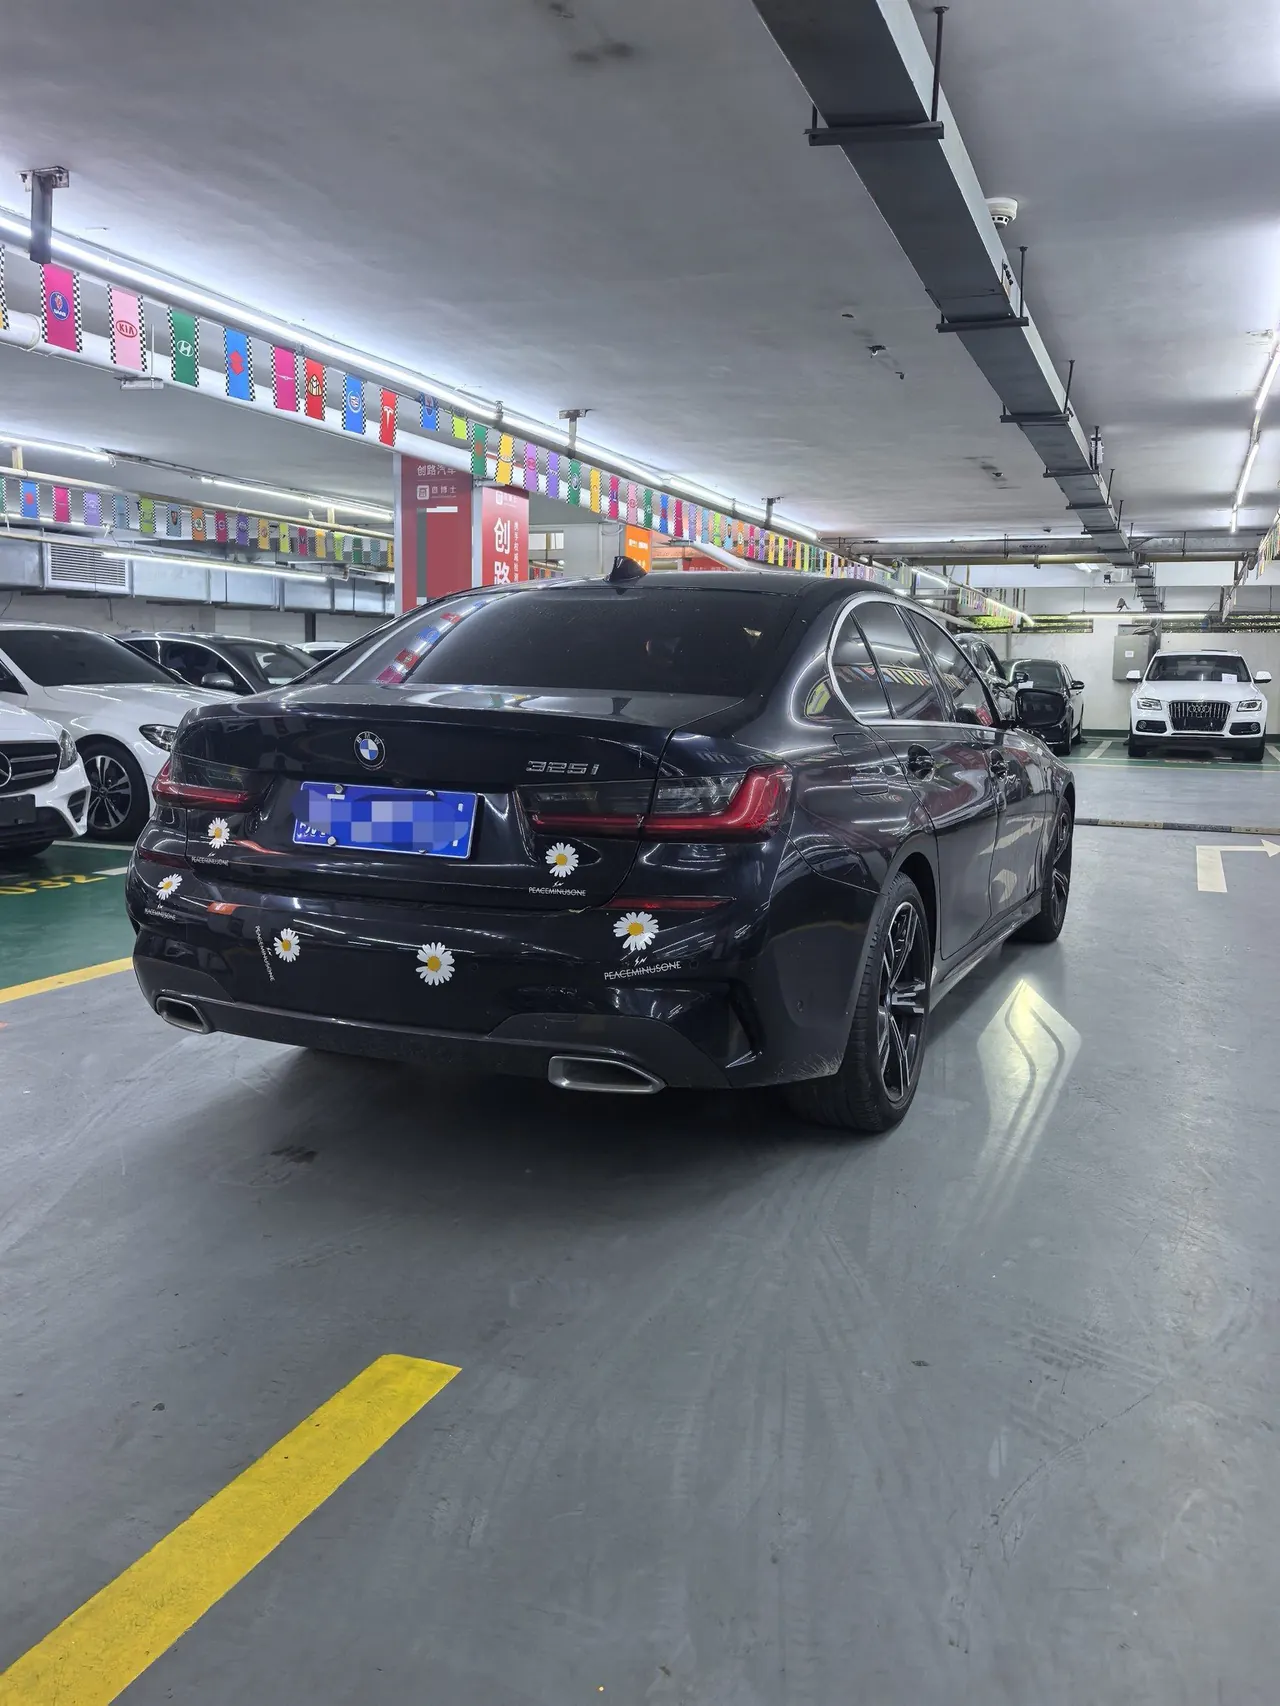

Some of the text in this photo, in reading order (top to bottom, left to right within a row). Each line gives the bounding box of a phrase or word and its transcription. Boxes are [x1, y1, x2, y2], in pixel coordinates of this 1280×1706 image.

[119, 323, 135, 336] KIA
[526, 760, 600, 775] 325i
[528, 886, 586, 897] PEACEMINUSONE
[604, 960, 682, 980] PEACEMINUSONE
